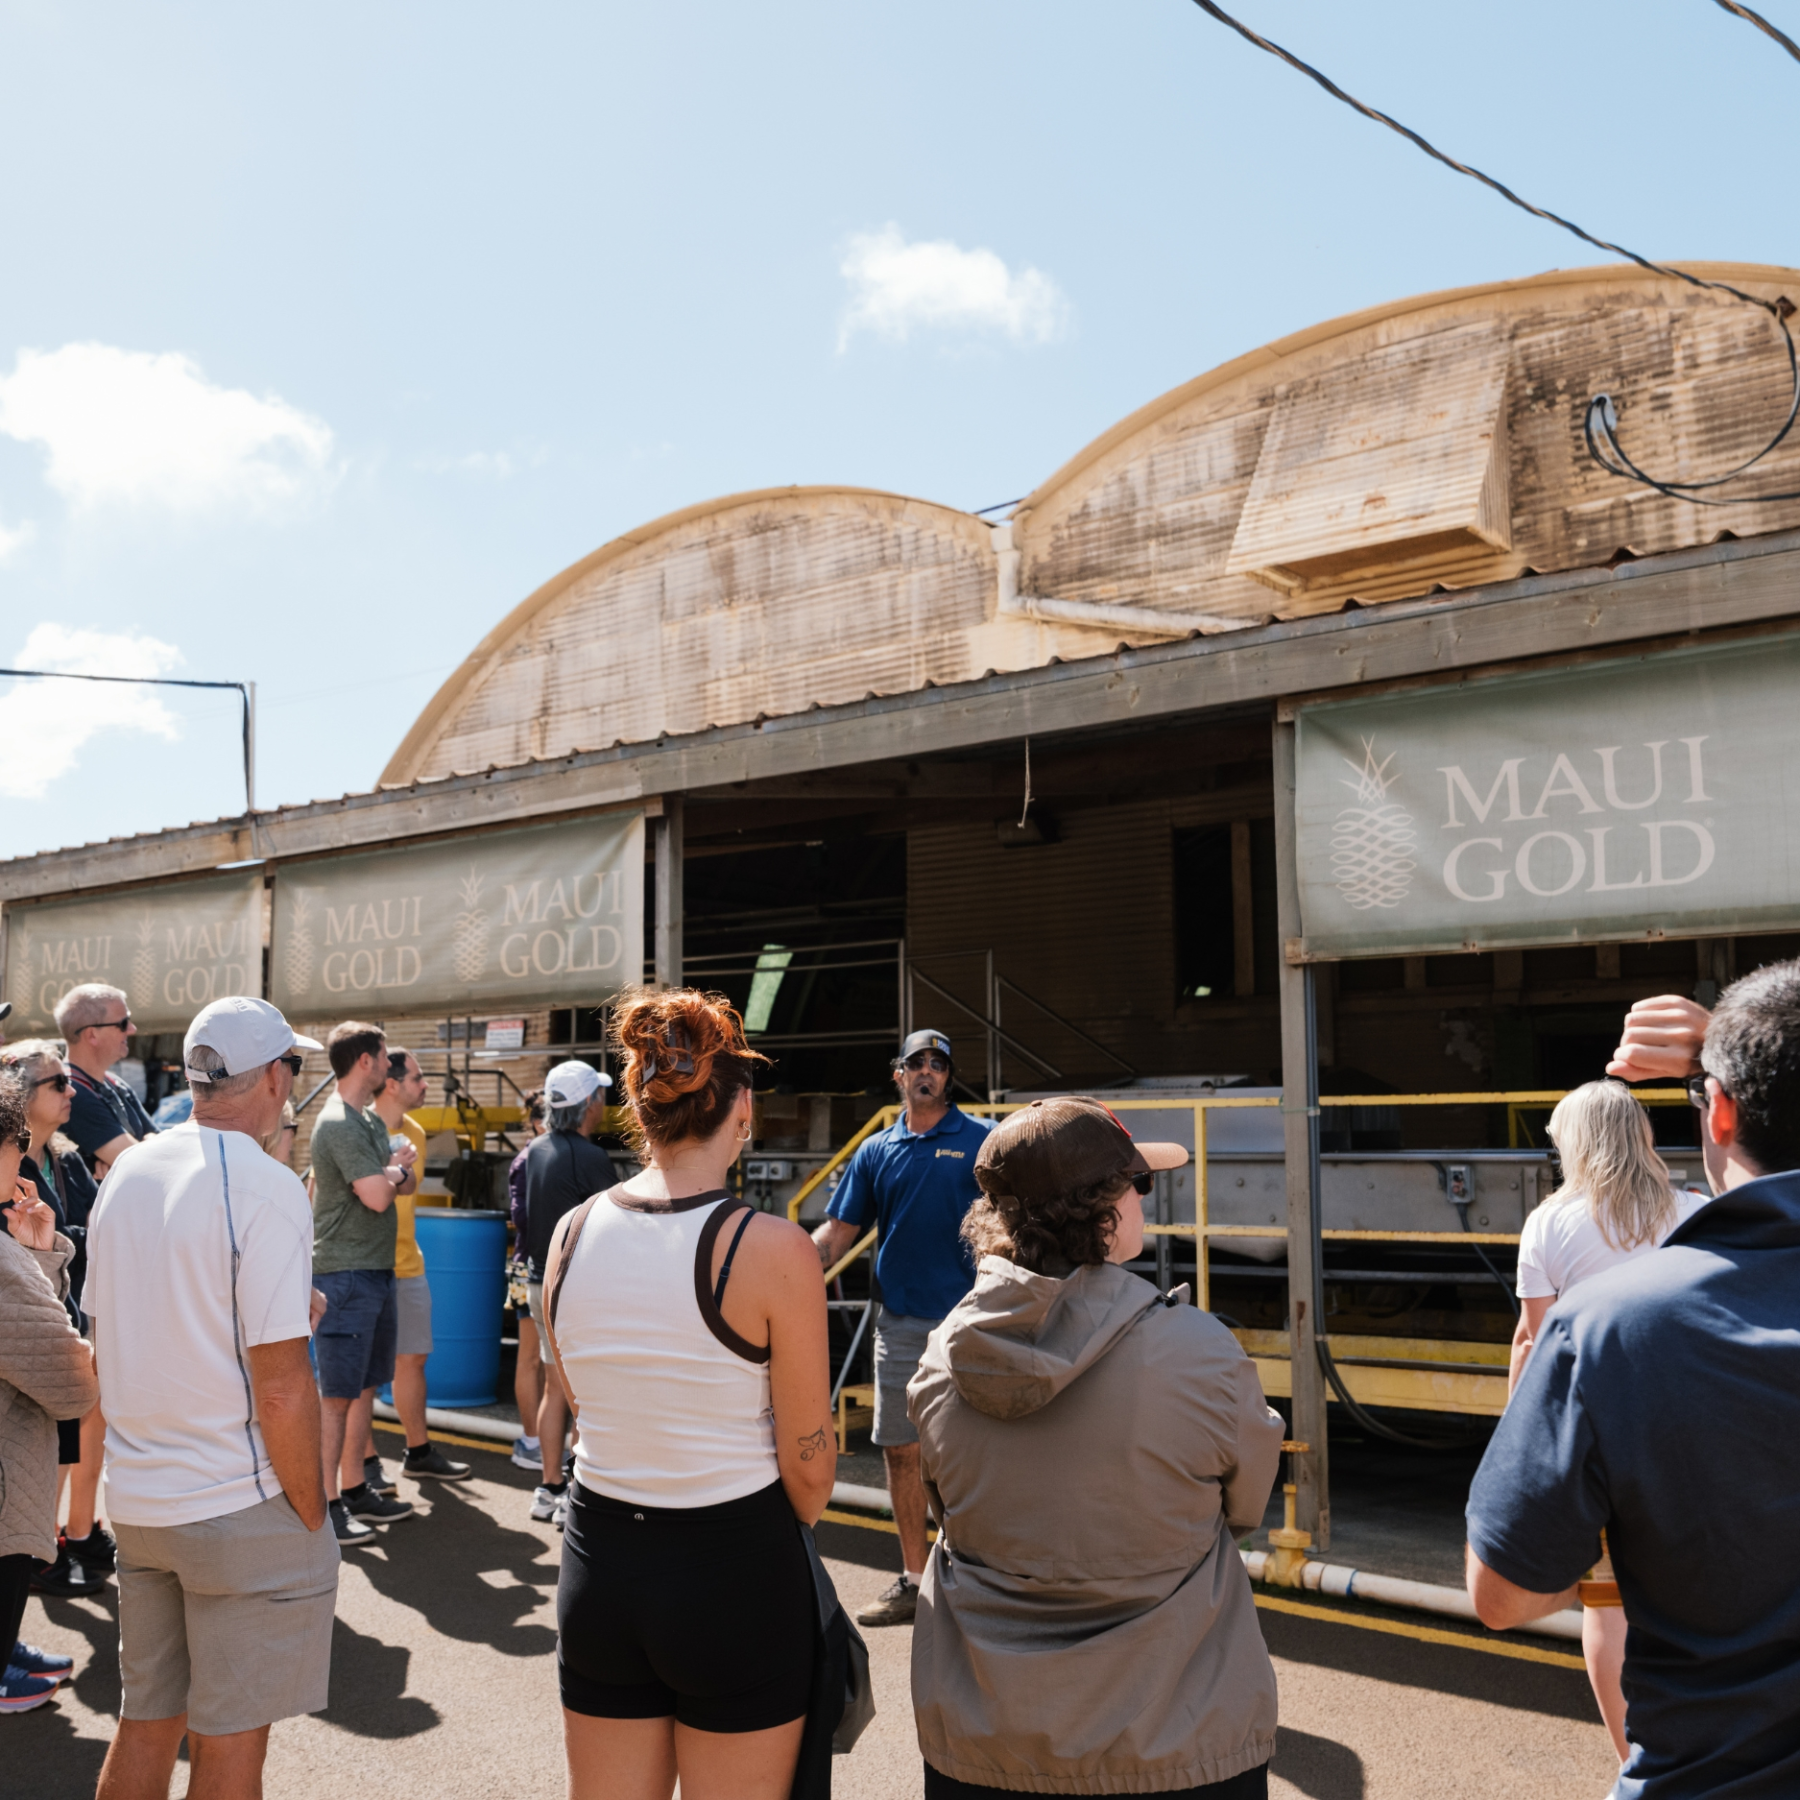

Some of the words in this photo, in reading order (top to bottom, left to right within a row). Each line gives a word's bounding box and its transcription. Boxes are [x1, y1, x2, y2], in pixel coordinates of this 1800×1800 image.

[1436, 735, 1714, 829] MAUI
[1443, 819, 1716, 902] GOLD
[324, 896, 423, 946] MAUI
[500, 870, 623, 926] MAUI
[40, 935, 113, 976] MAUI
[165, 918, 248, 964] MAUI
[500, 925, 622, 978] GOLD
[163, 963, 247, 1006] GOLD
[322, 945, 422, 992] GOLD
